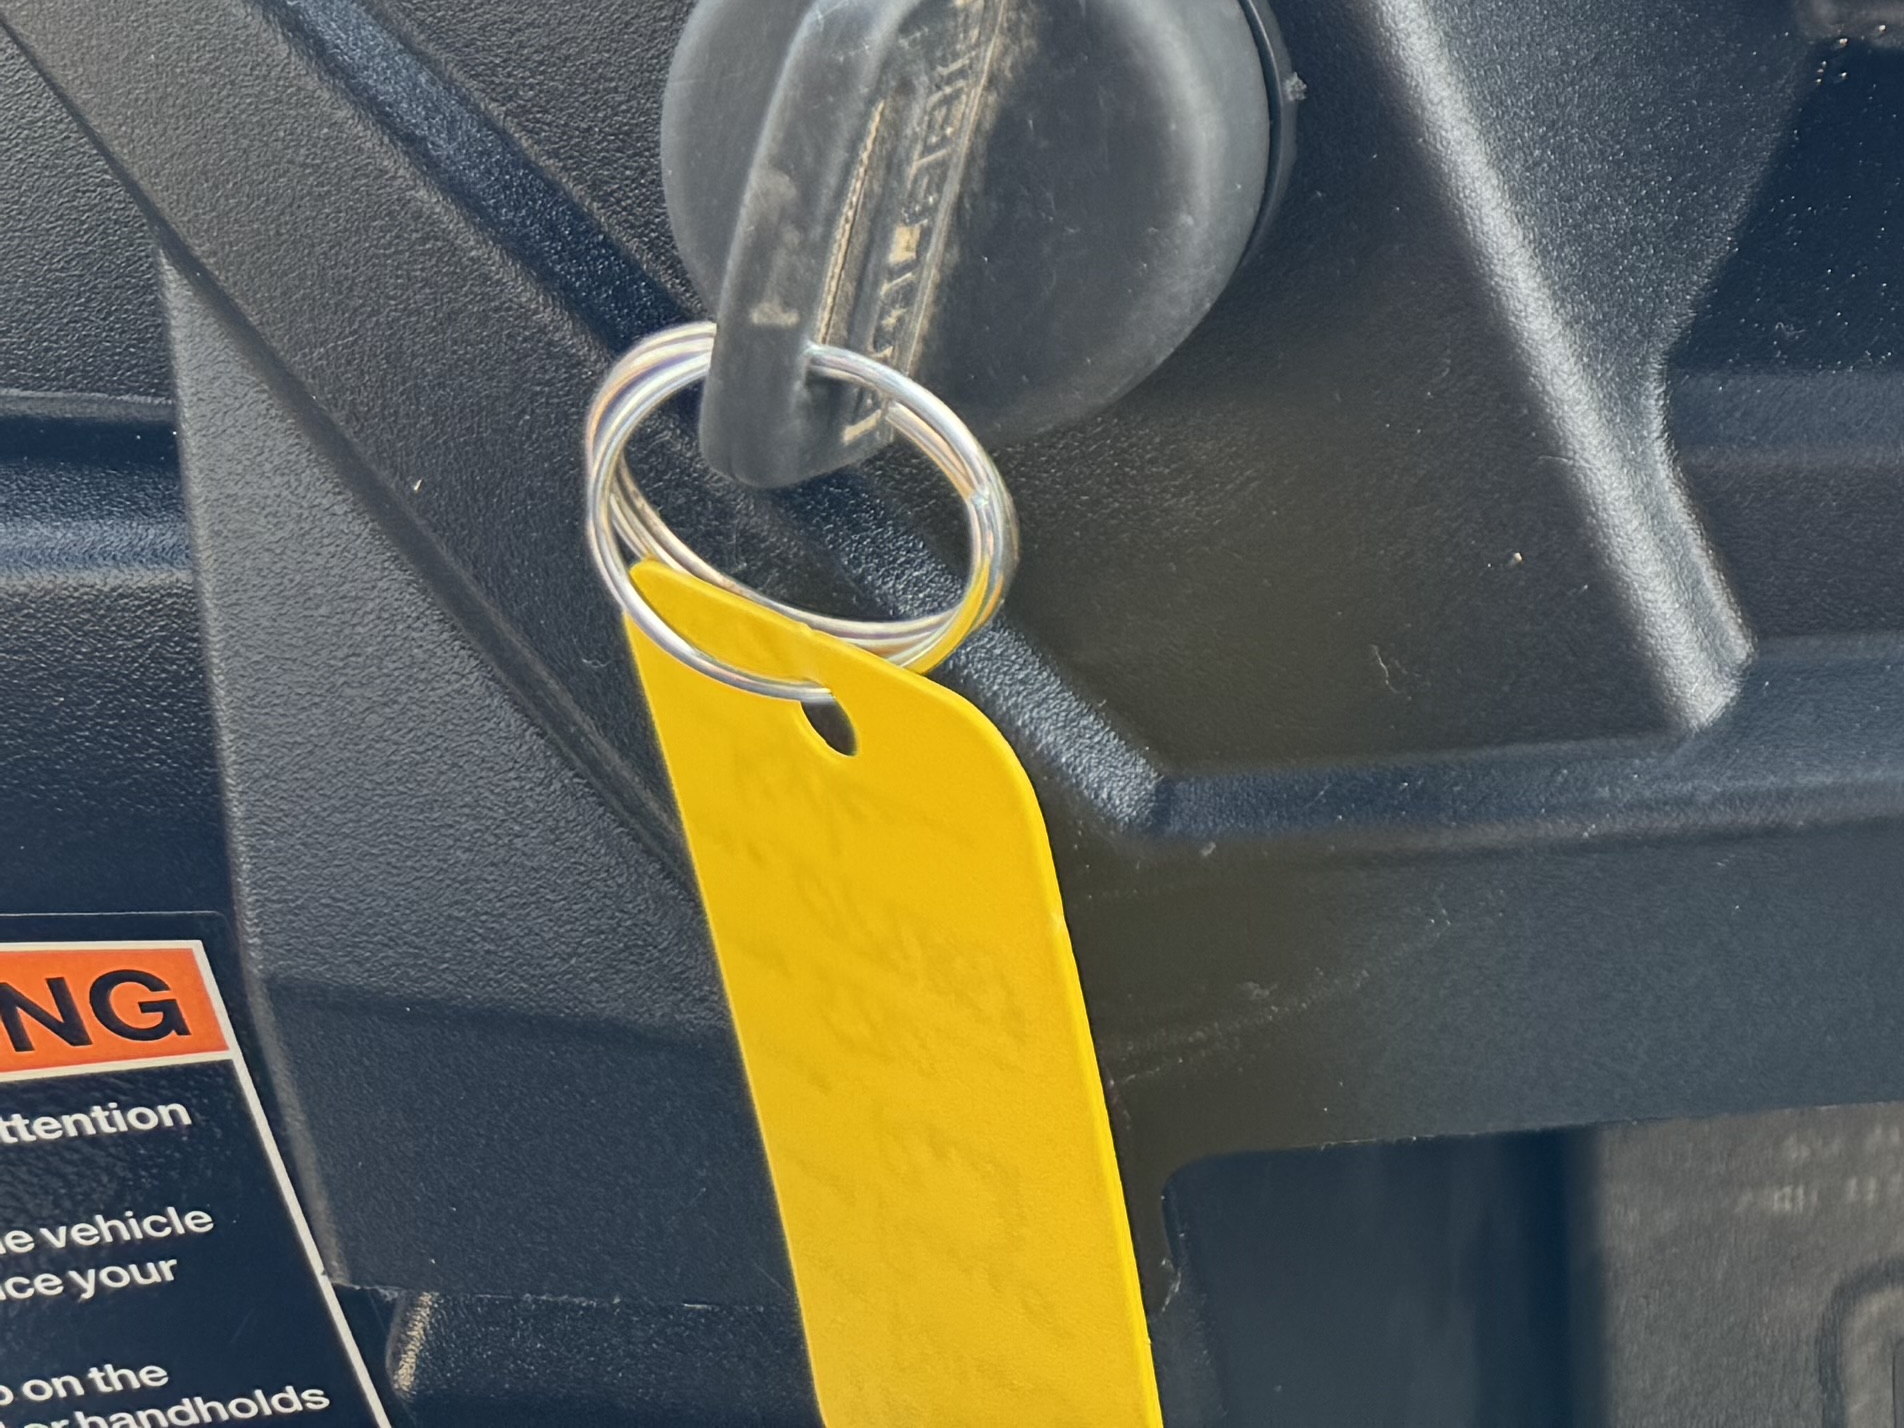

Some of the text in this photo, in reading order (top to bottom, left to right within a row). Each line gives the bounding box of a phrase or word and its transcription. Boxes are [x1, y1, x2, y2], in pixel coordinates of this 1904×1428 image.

[39, 1206, 215, 1249] vehicle
[68, 1259, 178, 1300] your
[22, 1375, 85, 1402] on
[88, 1363, 169, 1393] the
[74, 1385, 331, 1428] handholds
